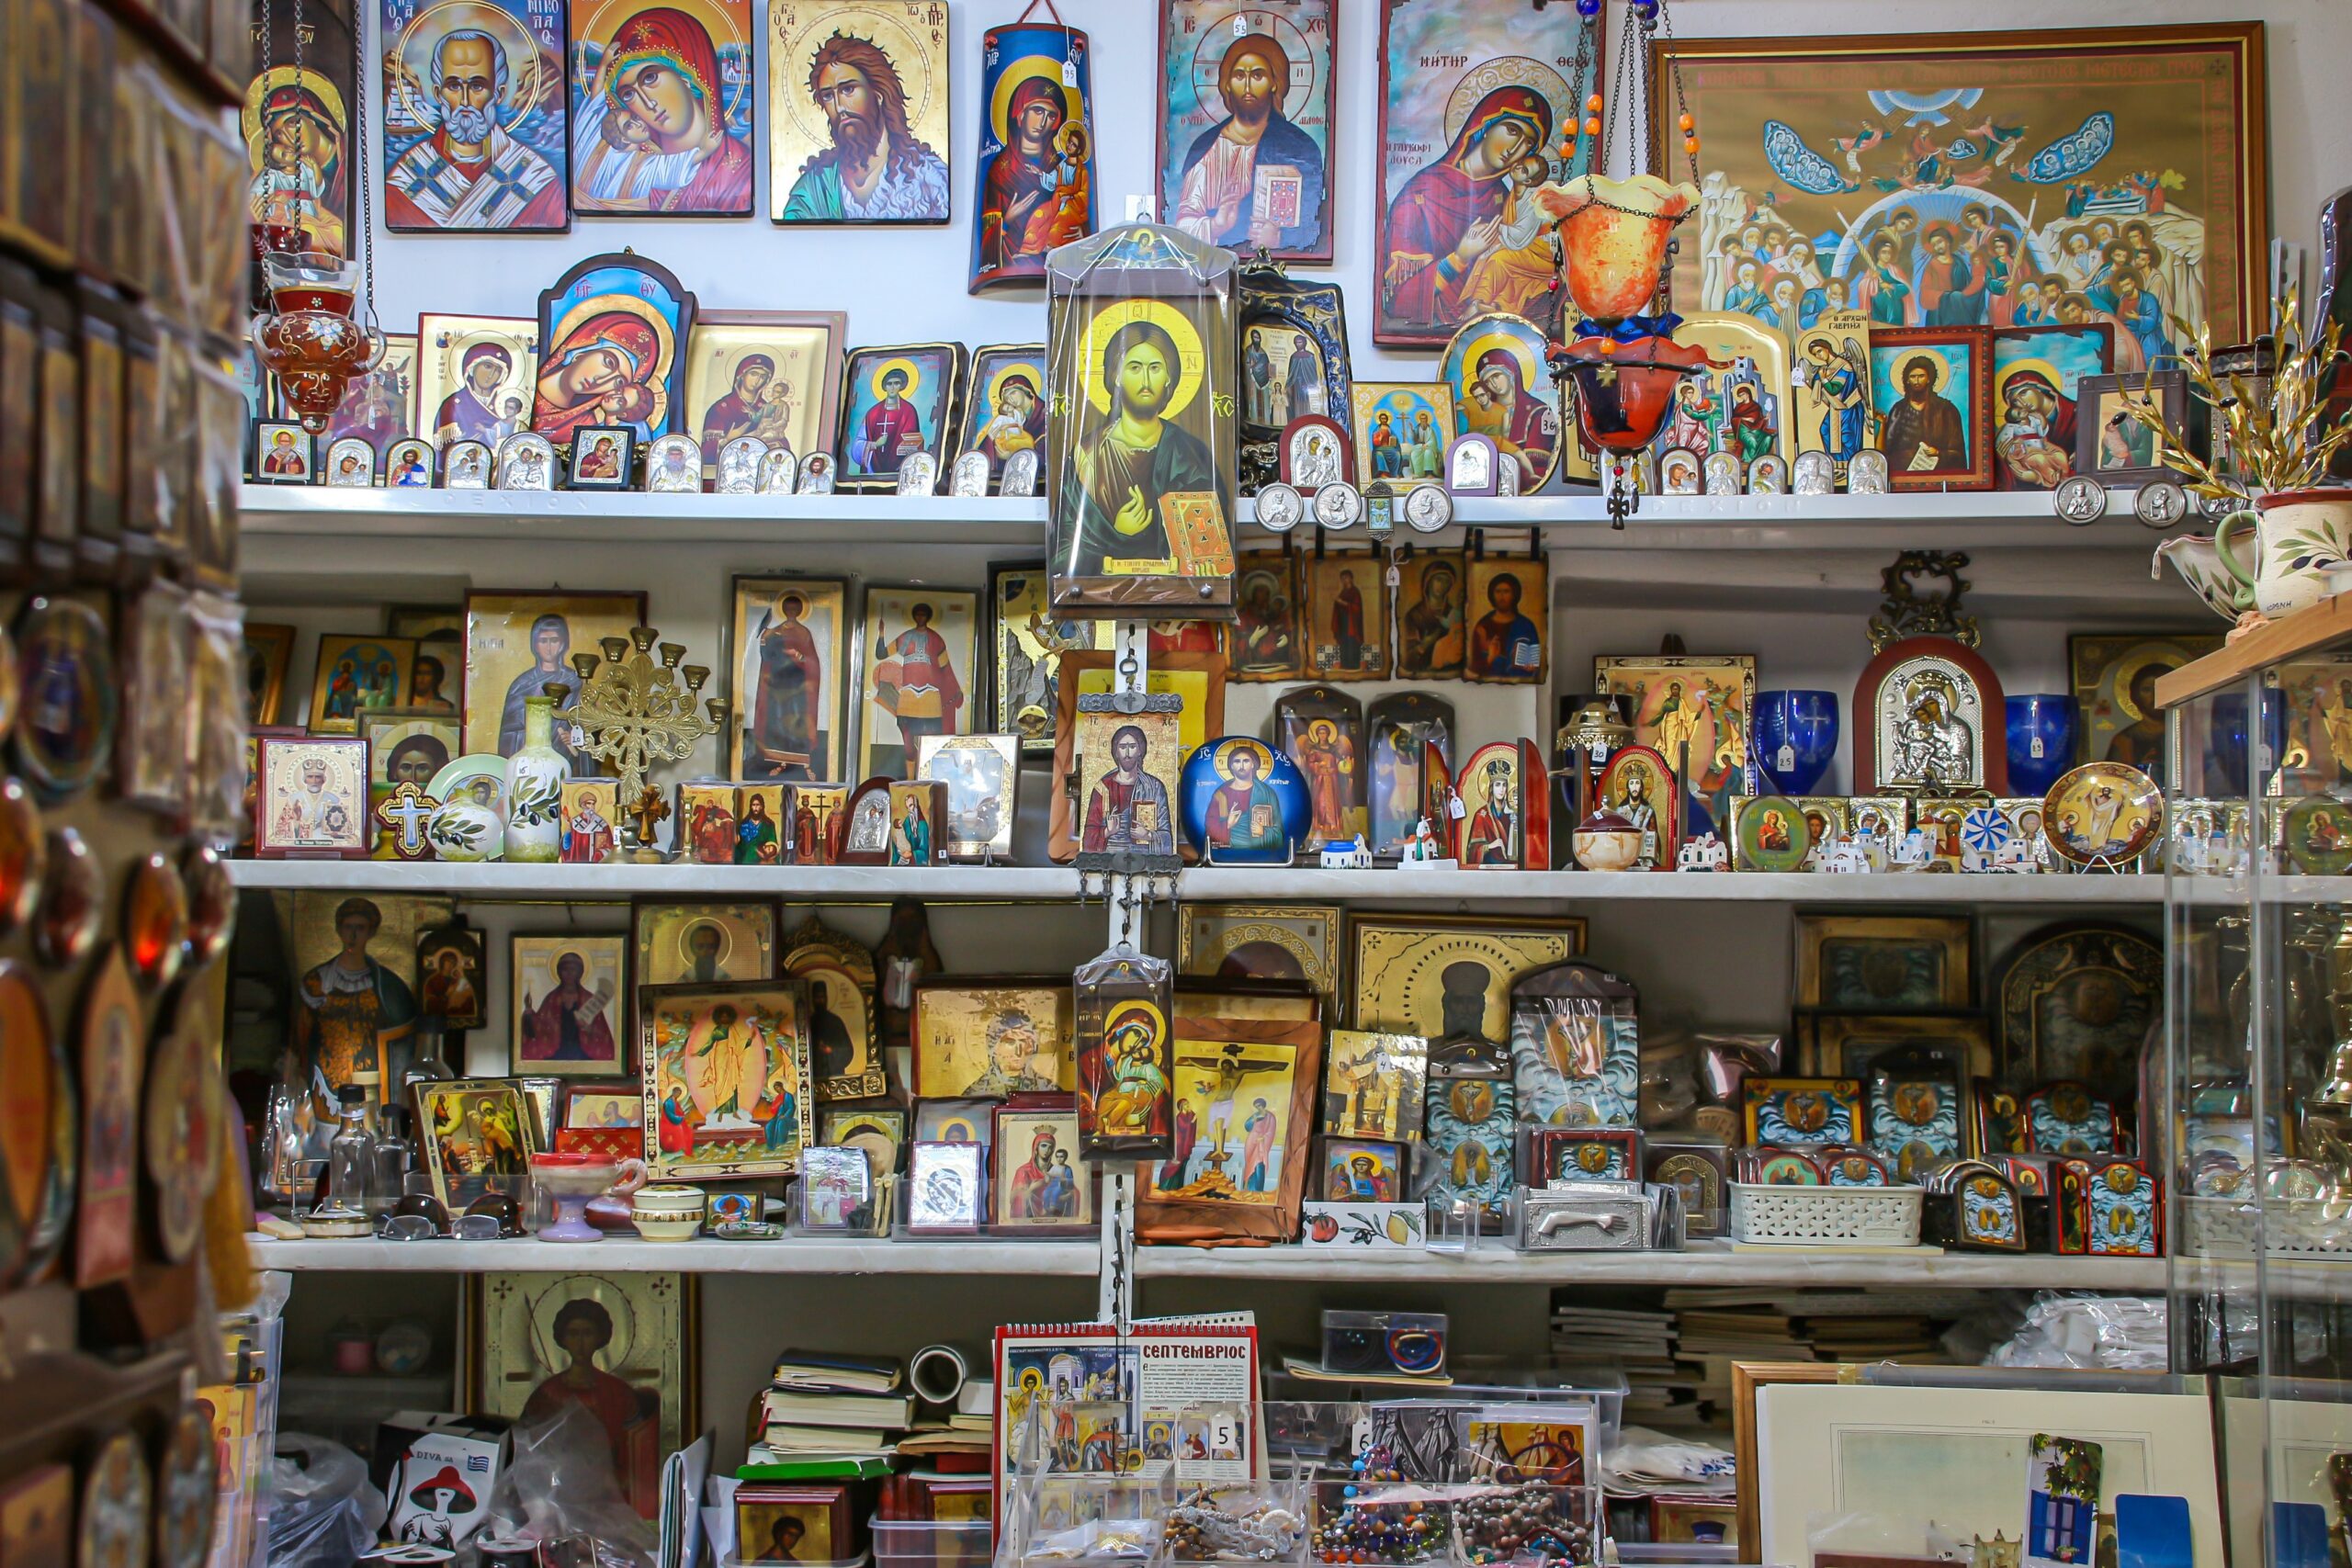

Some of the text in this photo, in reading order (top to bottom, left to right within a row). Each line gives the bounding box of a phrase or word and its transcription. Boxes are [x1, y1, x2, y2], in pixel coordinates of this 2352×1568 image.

[1235, 24, 1246, 35] 55
[1218, 1427, 1228, 1445] 5
[1360, 1434, 1369, 1451] 6
[416, 1451, 441, 1461] DIVA
